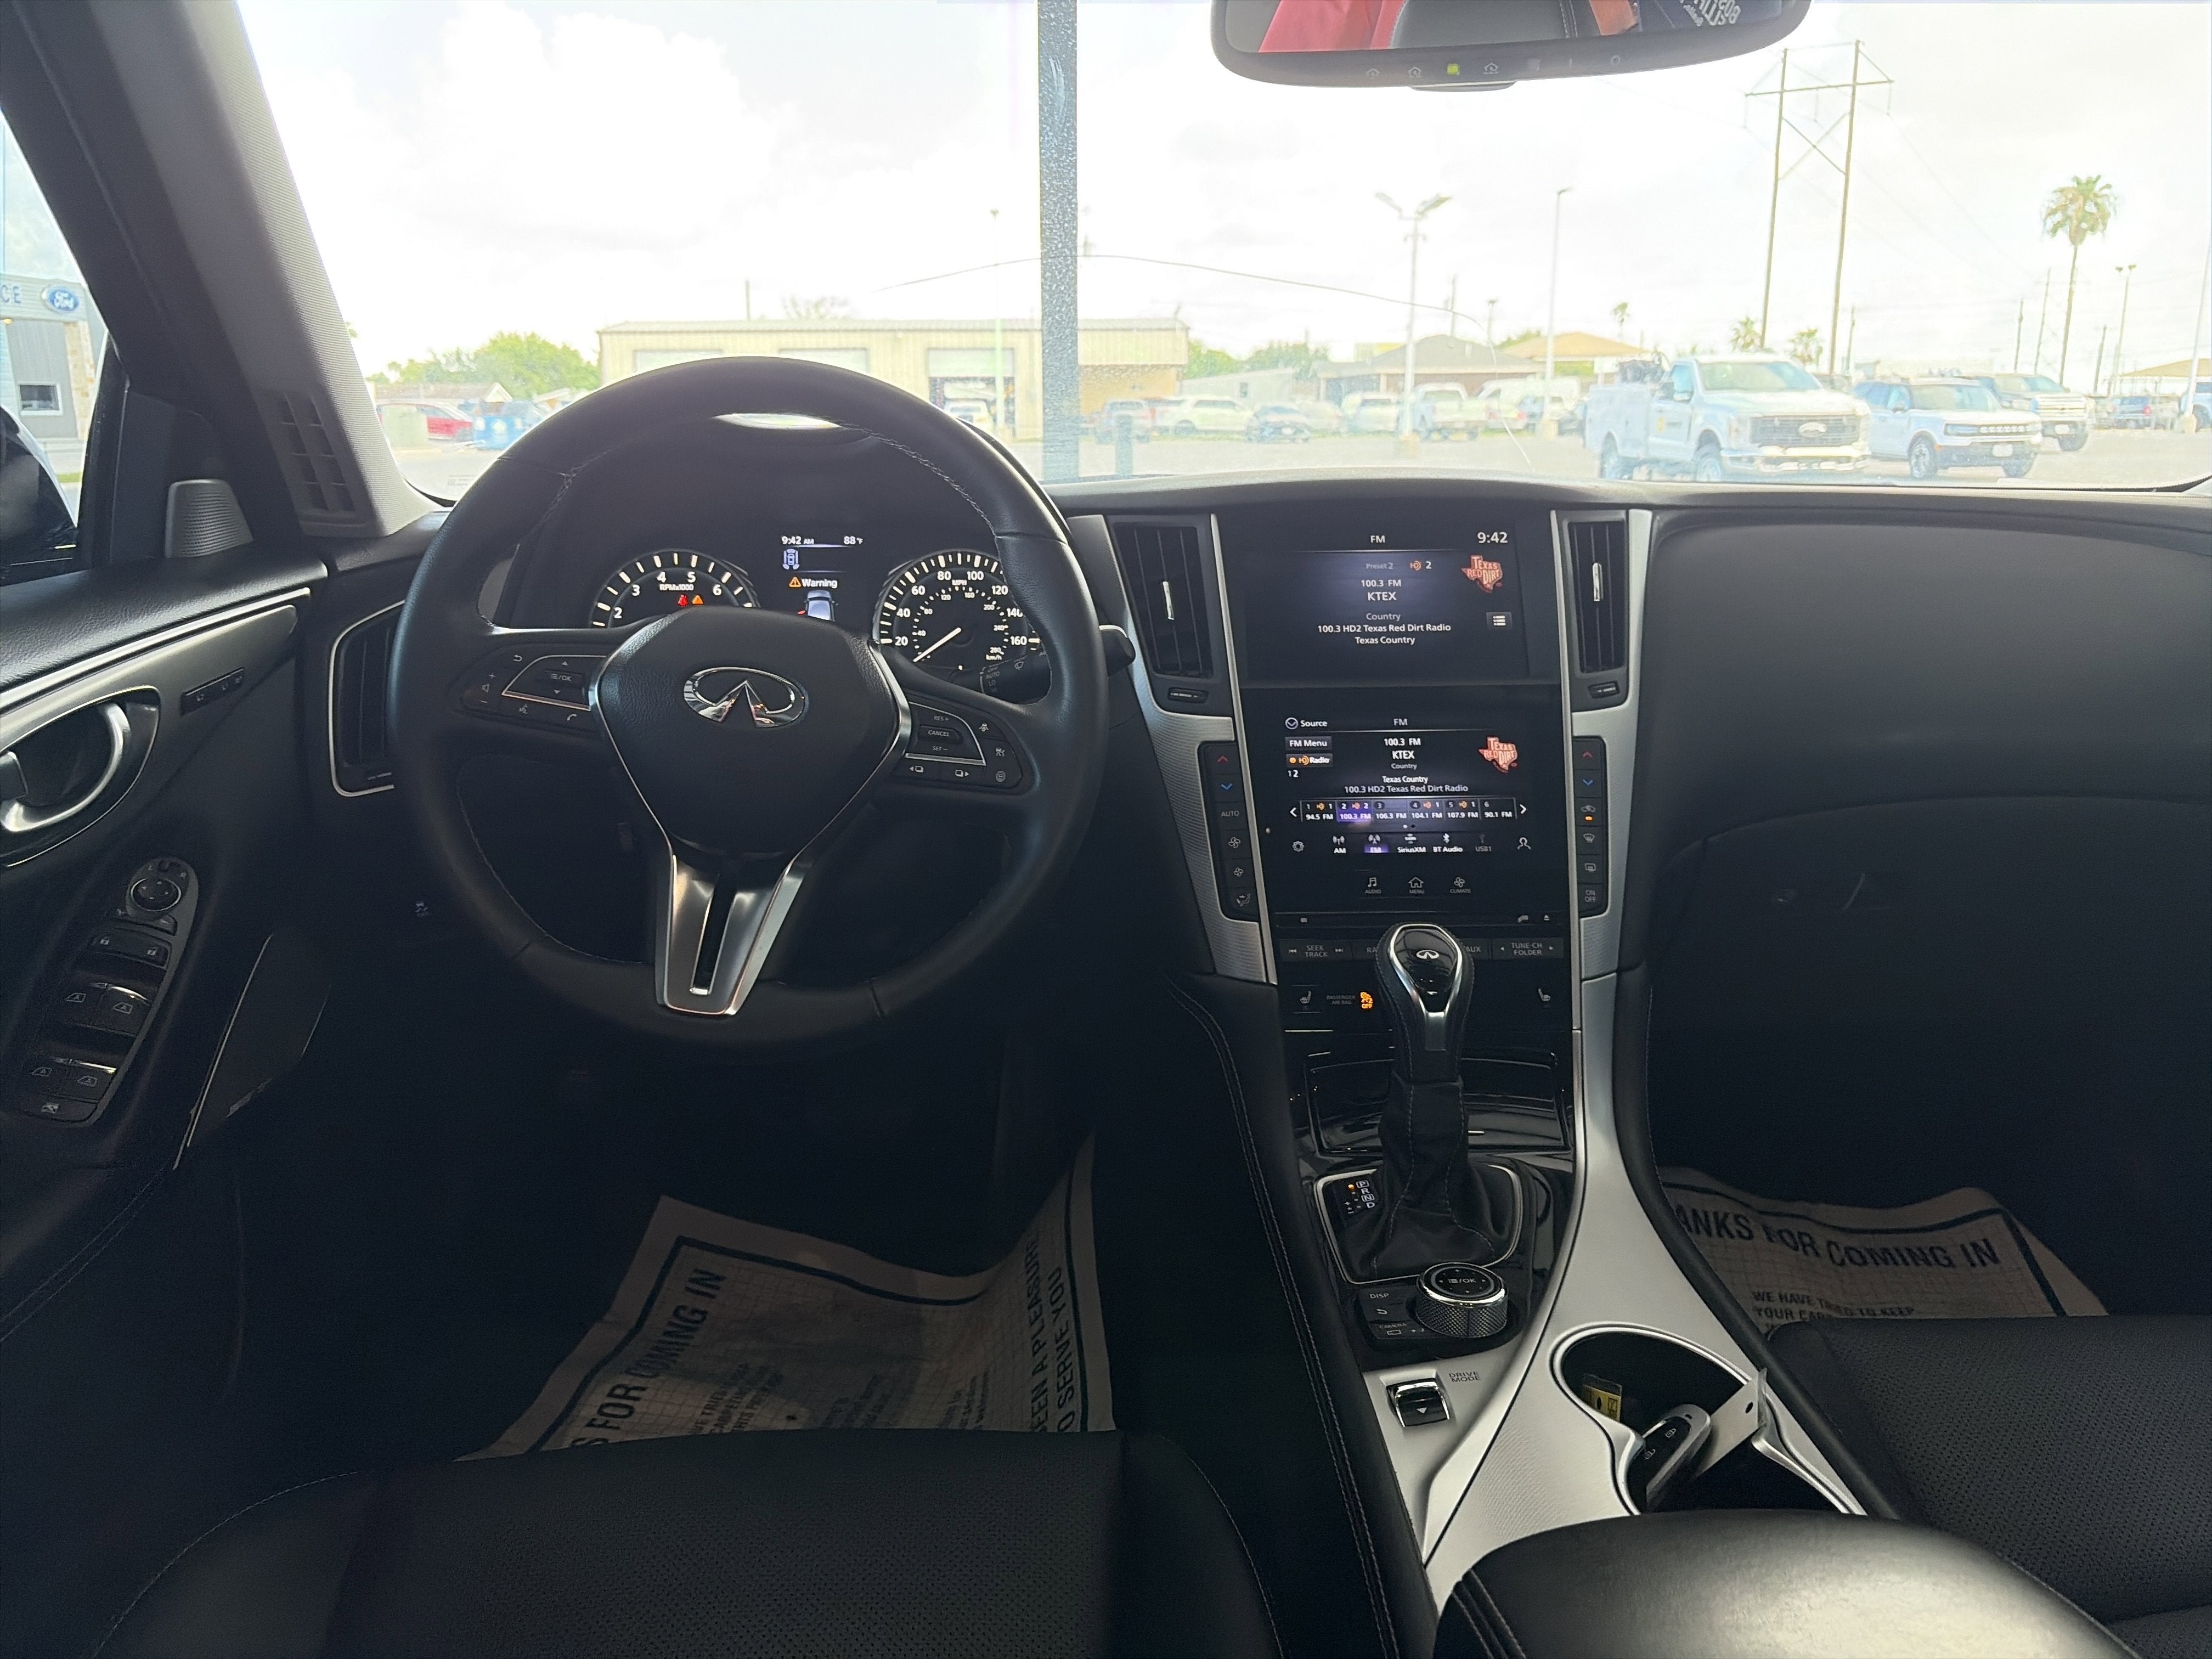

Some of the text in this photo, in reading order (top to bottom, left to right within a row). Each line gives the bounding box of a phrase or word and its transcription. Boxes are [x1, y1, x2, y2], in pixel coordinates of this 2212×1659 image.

[781, 536, 802, 544] 9:42
[1477, 532, 1508, 544] 9:42
[1426, 561, 1432, 569] 2
[657, 572, 666, 583] 4
[687, 572, 696, 583] 5
[937, 571, 951, 580] 80
[967, 571, 984, 580] 100
[1467, 568, 1482, 578] RED
[1482, 570, 1500, 584] DIRT
[802, 579, 838, 589] Warning
[631, 585, 640, 596] 3
[713, 584, 721, 596] 6
[911, 585, 926, 595] 60
[991, 585, 1008, 595] 120
[1367, 591, 1397, 601] KTEX
[614, 607, 623, 619] 2
[896, 608, 911, 618] 40
[1006, 608, 1023, 617] 140
[1366, 613, 1401, 621] Country
[1318, 625, 1341, 633] 100.3
[1426, 624, 1451, 632] Radio
[895, 636, 909, 646] 20
[1011, 636, 1027, 645] 160
[1355, 636, 1415, 645] Texas Country
[986, 671, 1000, 679] AUTO
[1384, 738, 1405, 746] 100.3
[1392, 751, 1415, 759] KTEX
[1483, 749, 1498, 759] RED
[1499, 751, 1515, 765] DIRT
[1293, 769, 1299, 778] 2
[1402, 775, 1428, 784] Country
[1675, 1204, 2000, 1268] ANKS FOR COMING IN
[1048, 1266, 1066, 1325] YOU
[1752, 1291, 1774, 1302] WE
[1778, 1292, 1813, 1306] HAVE
[1756, 1307, 1795, 1320] YOUR
[586, 1383, 648, 1430] FOR
[624, 1305, 708, 1379] COMING
[685, 1267, 727, 1299] IN
[1032, 1353, 1047, 1376] A
[1054, 1319, 1075, 1409] SERVE
[1031, 1378, 1048, 1432] EEN
